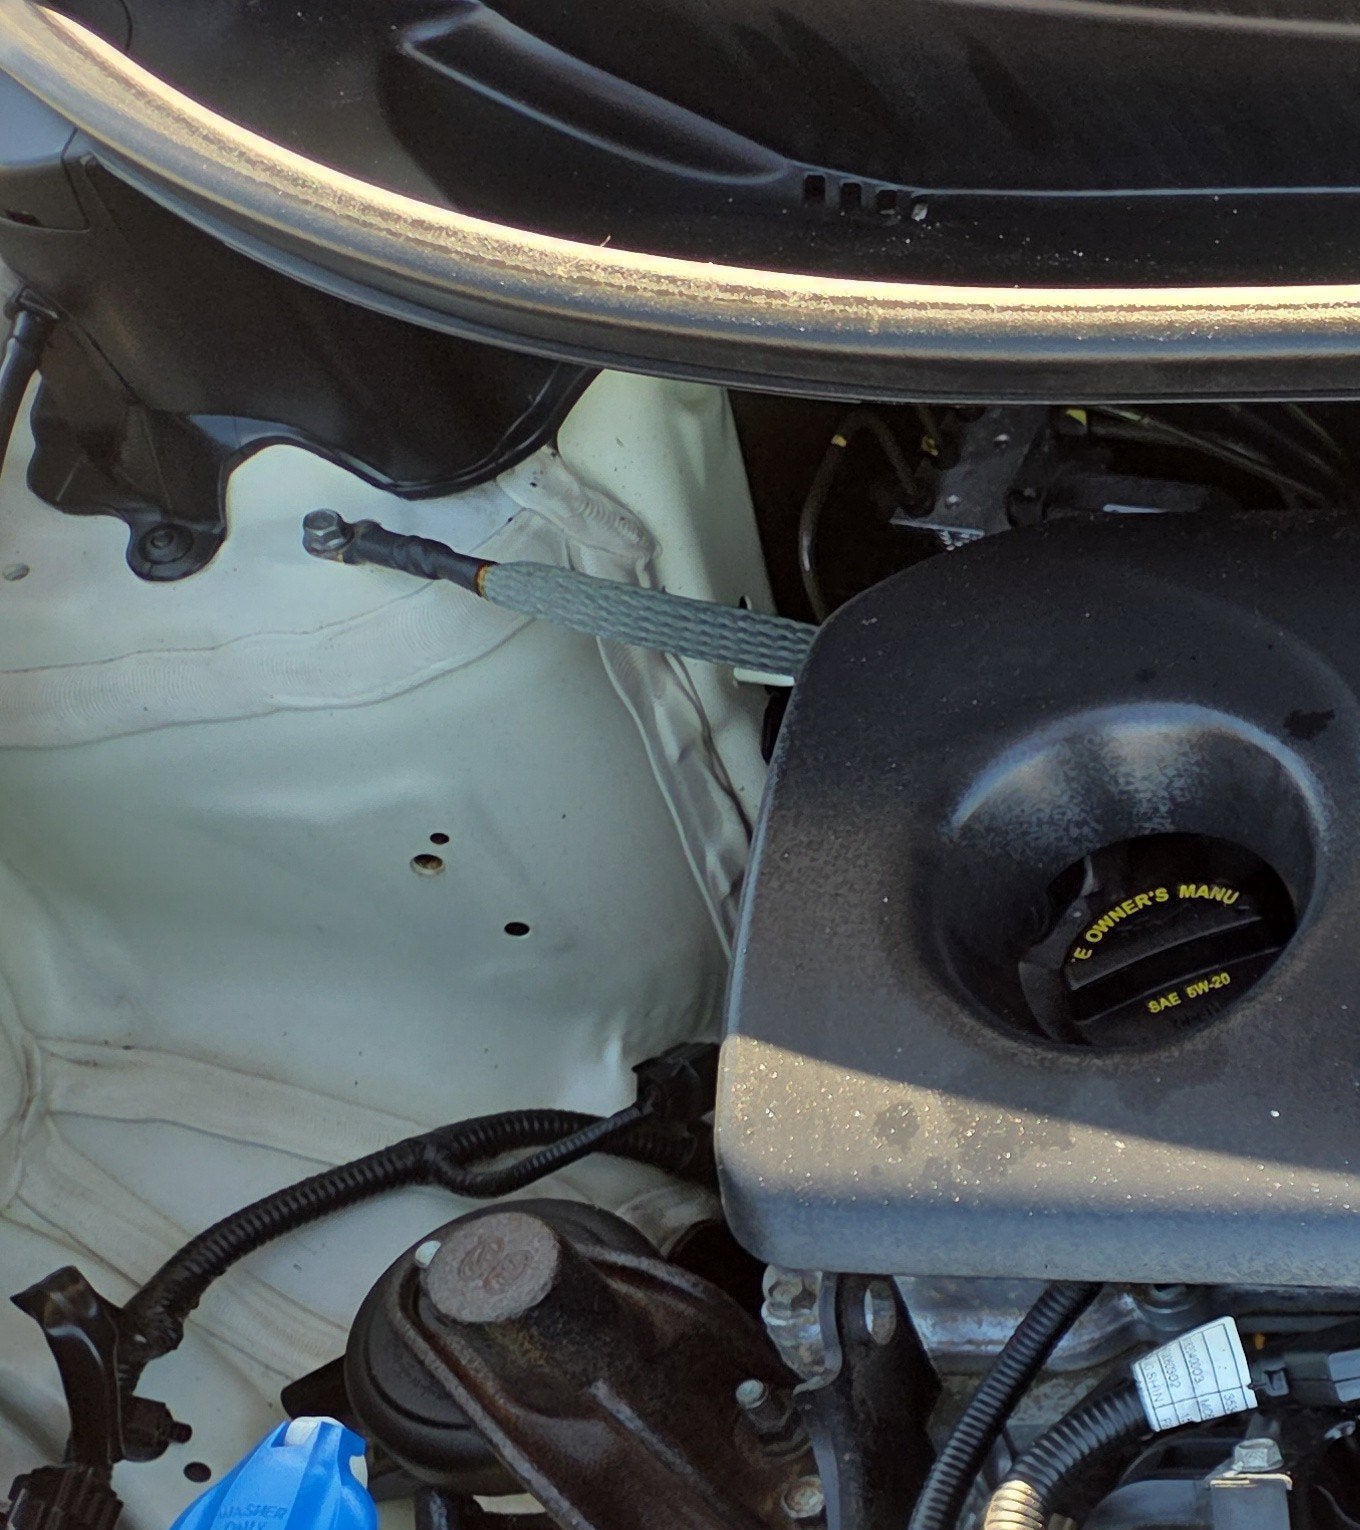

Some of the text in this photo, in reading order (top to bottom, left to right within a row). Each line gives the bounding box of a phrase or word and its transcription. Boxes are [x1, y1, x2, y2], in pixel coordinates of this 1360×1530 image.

[1085, 887, 1170, 943] OWNER'S
[1179, 884, 1240, 905] MANU
[1148, 972, 1231, 1014] SAE 5W-20
[220, 1502, 288, 1519] WASHER
